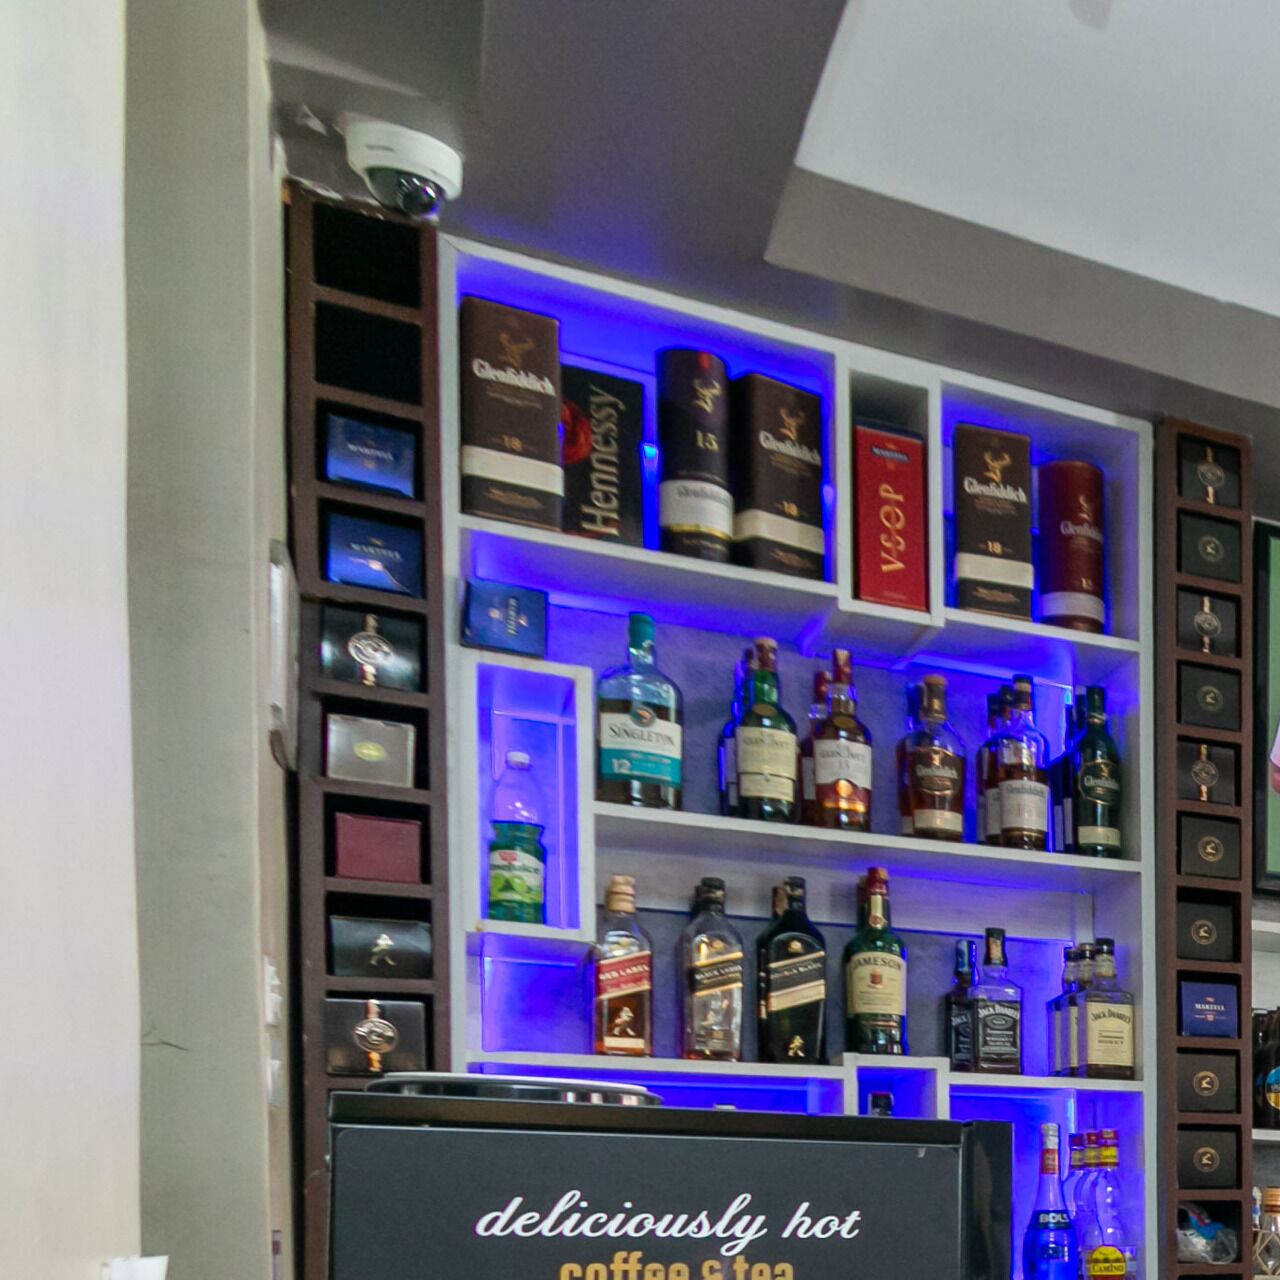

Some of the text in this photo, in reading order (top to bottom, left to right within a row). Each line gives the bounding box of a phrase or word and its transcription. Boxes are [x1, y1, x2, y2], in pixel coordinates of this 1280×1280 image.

[472, 358, 557, 396] Glenfiddich
[579, 384, 627, 537] Hennessy
[963, 476, 1028, 503] Glenfiddich
[854, 956, 902, 971] JAMESON
[473, 1189, 862, 1257] deliciously hot
